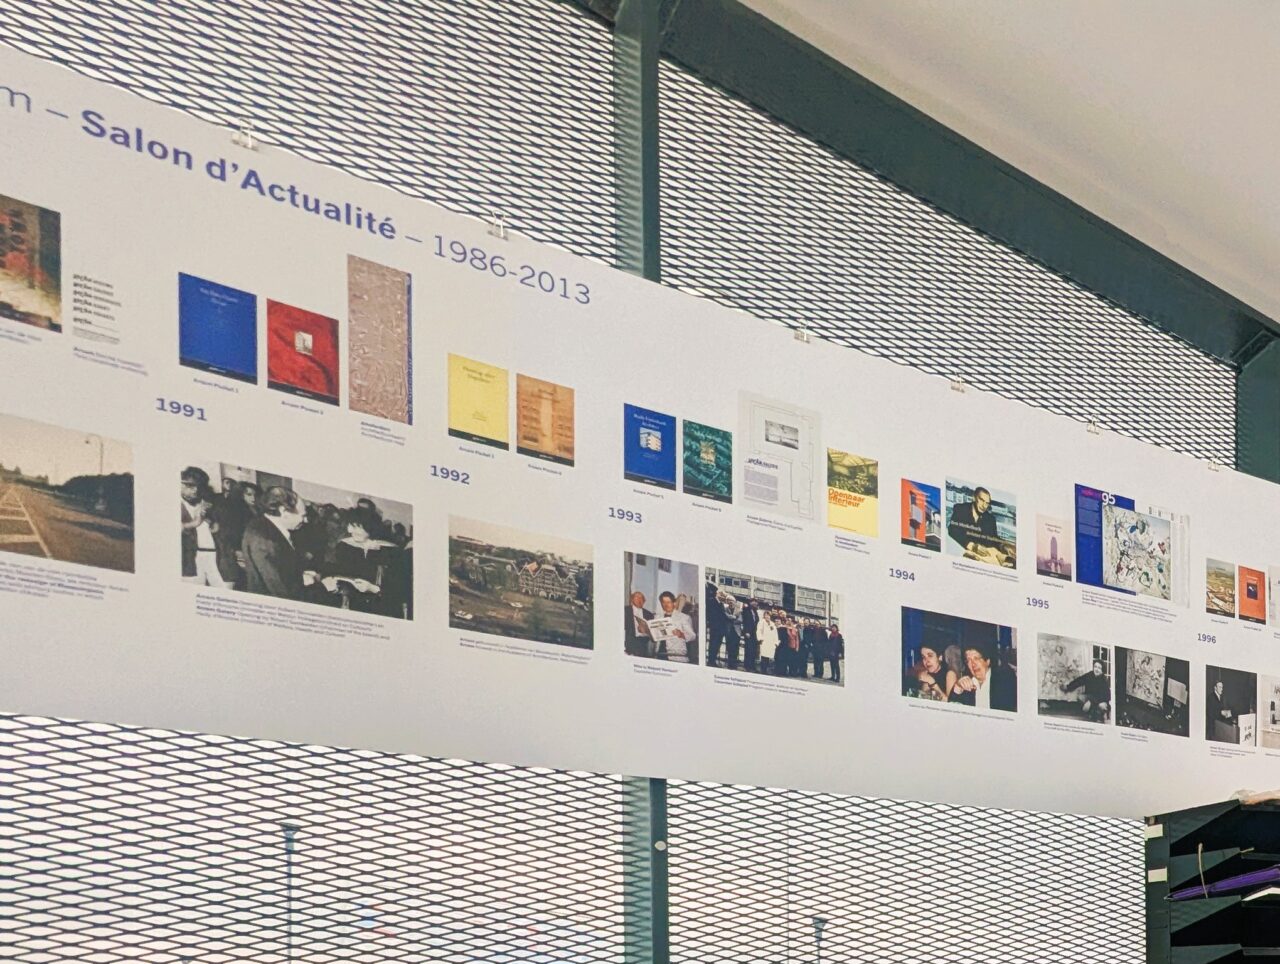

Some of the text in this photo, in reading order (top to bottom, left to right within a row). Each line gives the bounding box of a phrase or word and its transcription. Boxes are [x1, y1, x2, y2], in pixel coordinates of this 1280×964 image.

[81, 110, 193, 171] Salon
[206, 158, 396, 240] d’Actualité
[434, 236, 590, 305] 1986-2013
[156, 398, 207, 421] 1991
[431, 465, 470, 485] 1992
[828, 488, 865, 503] Openbaar
[1102, 492, 1115, 505] 95
[608, 507, 642, 523] 1993
[889, 568, 915, 582] 1994
[1026, 597, 1050, 610] 1995
[1197, 633, 1217, 644] 1996
